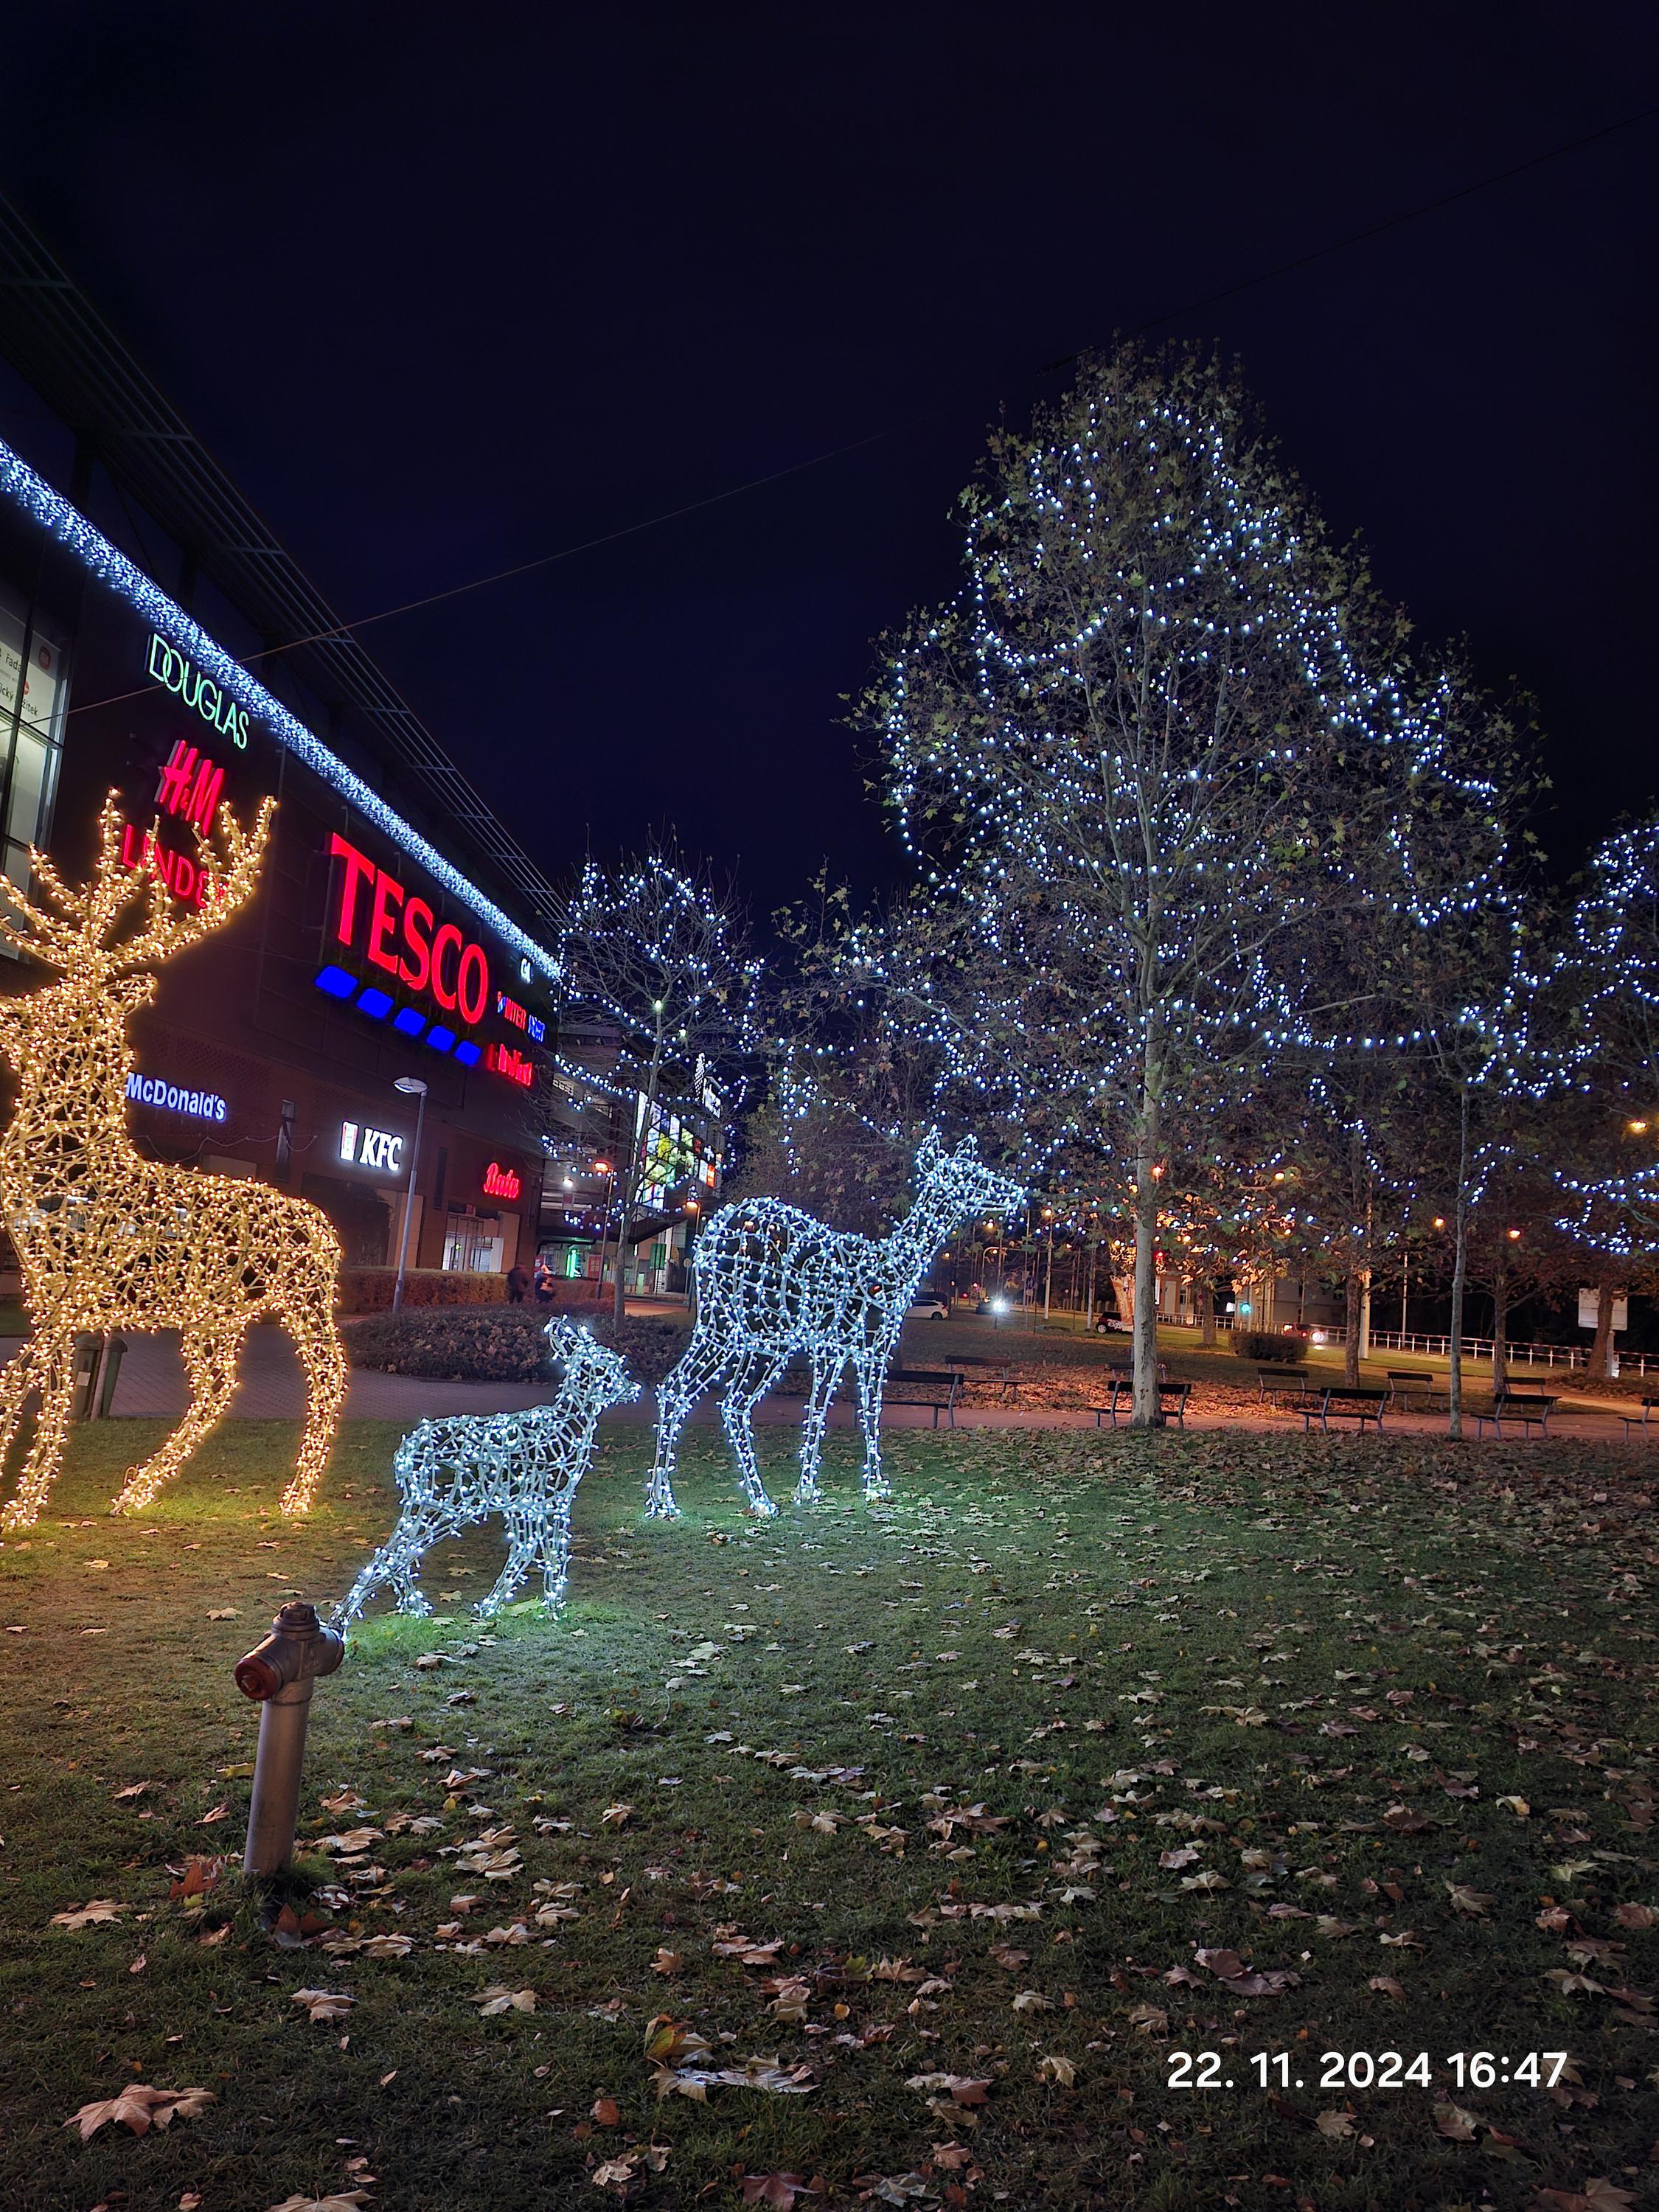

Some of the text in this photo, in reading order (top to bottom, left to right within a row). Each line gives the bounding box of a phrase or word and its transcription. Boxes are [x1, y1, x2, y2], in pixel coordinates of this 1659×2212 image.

[149, 633, 249, 749] DOUGLAS
[158, 740, 224, 836] H&M
[123, 824, 227, 908] LINDE
[330, 832, 488, 1023] TESCO
[125, 1071, 226, 1120] McDonald's
[359, 1128, 403, 1171] KFC
